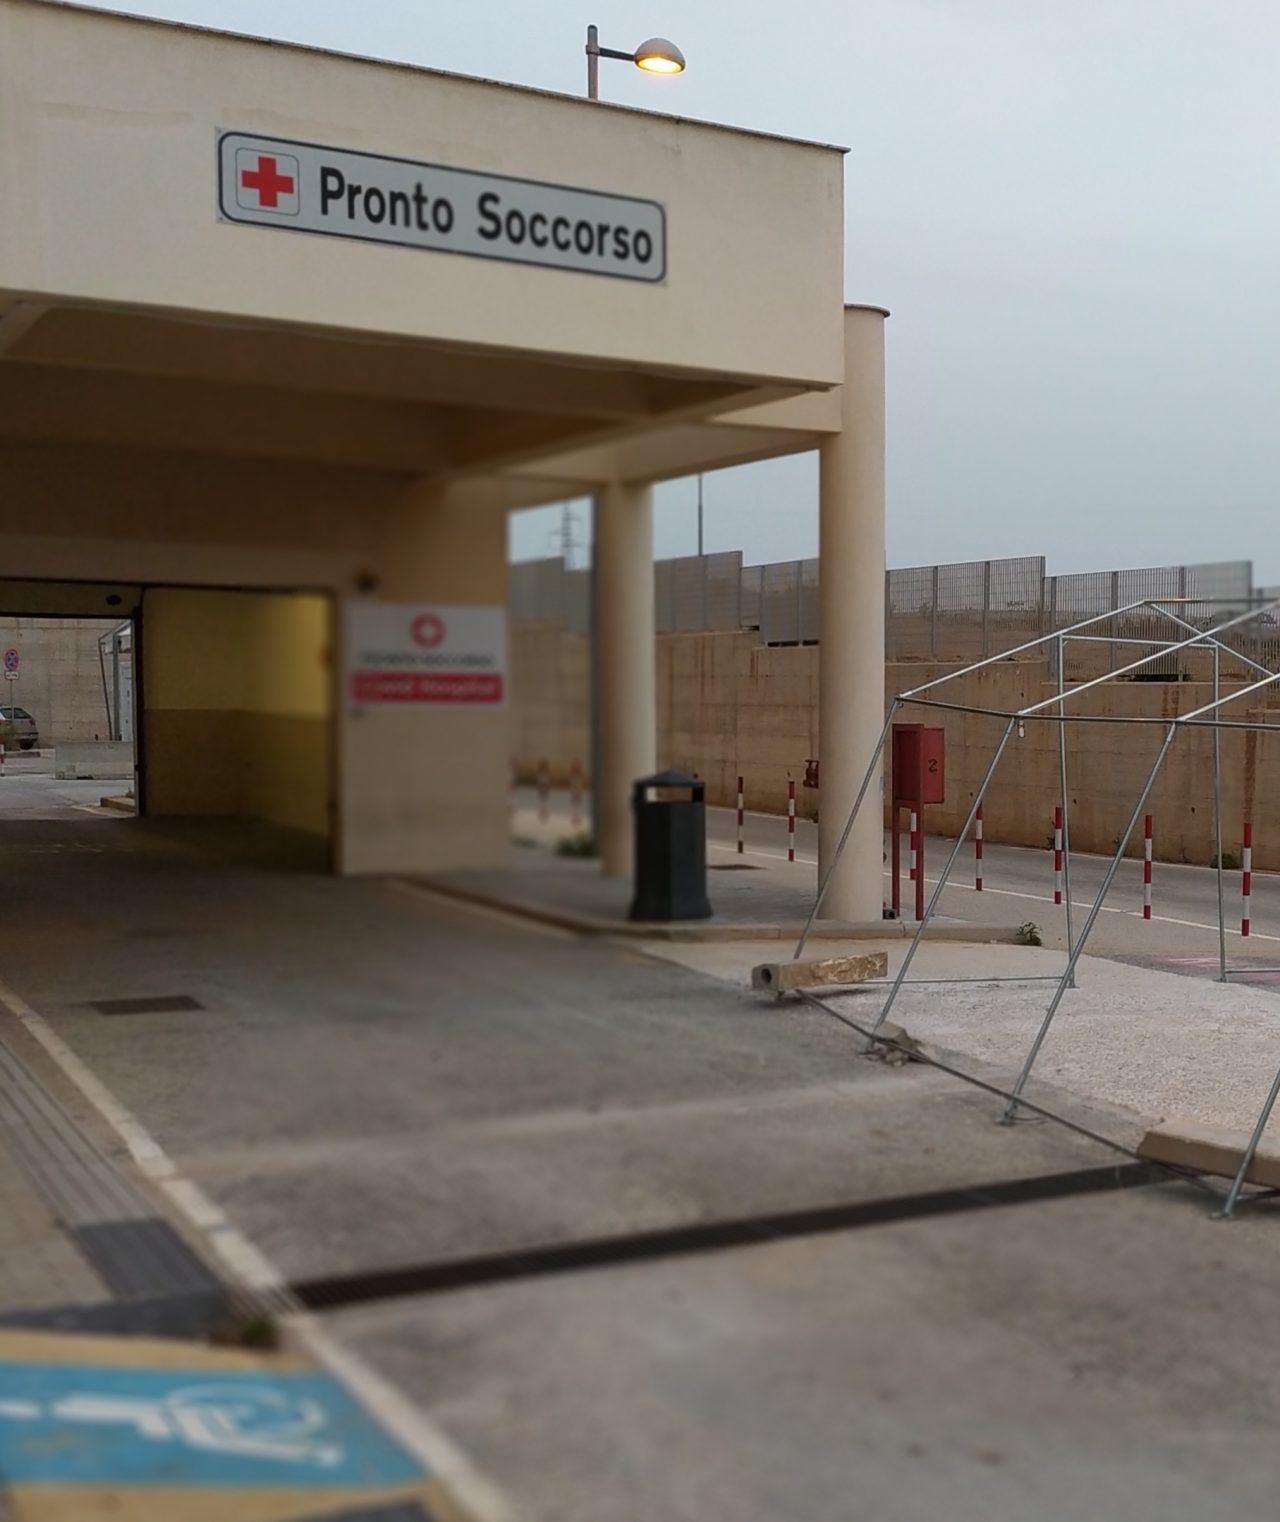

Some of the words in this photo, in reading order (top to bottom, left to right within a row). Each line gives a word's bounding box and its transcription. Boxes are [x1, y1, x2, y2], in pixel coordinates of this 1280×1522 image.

[319, 165, 455, 234] Pronto
[476, 191, 654, 264] Soccorso
[927, 758, 938, 773] 2
